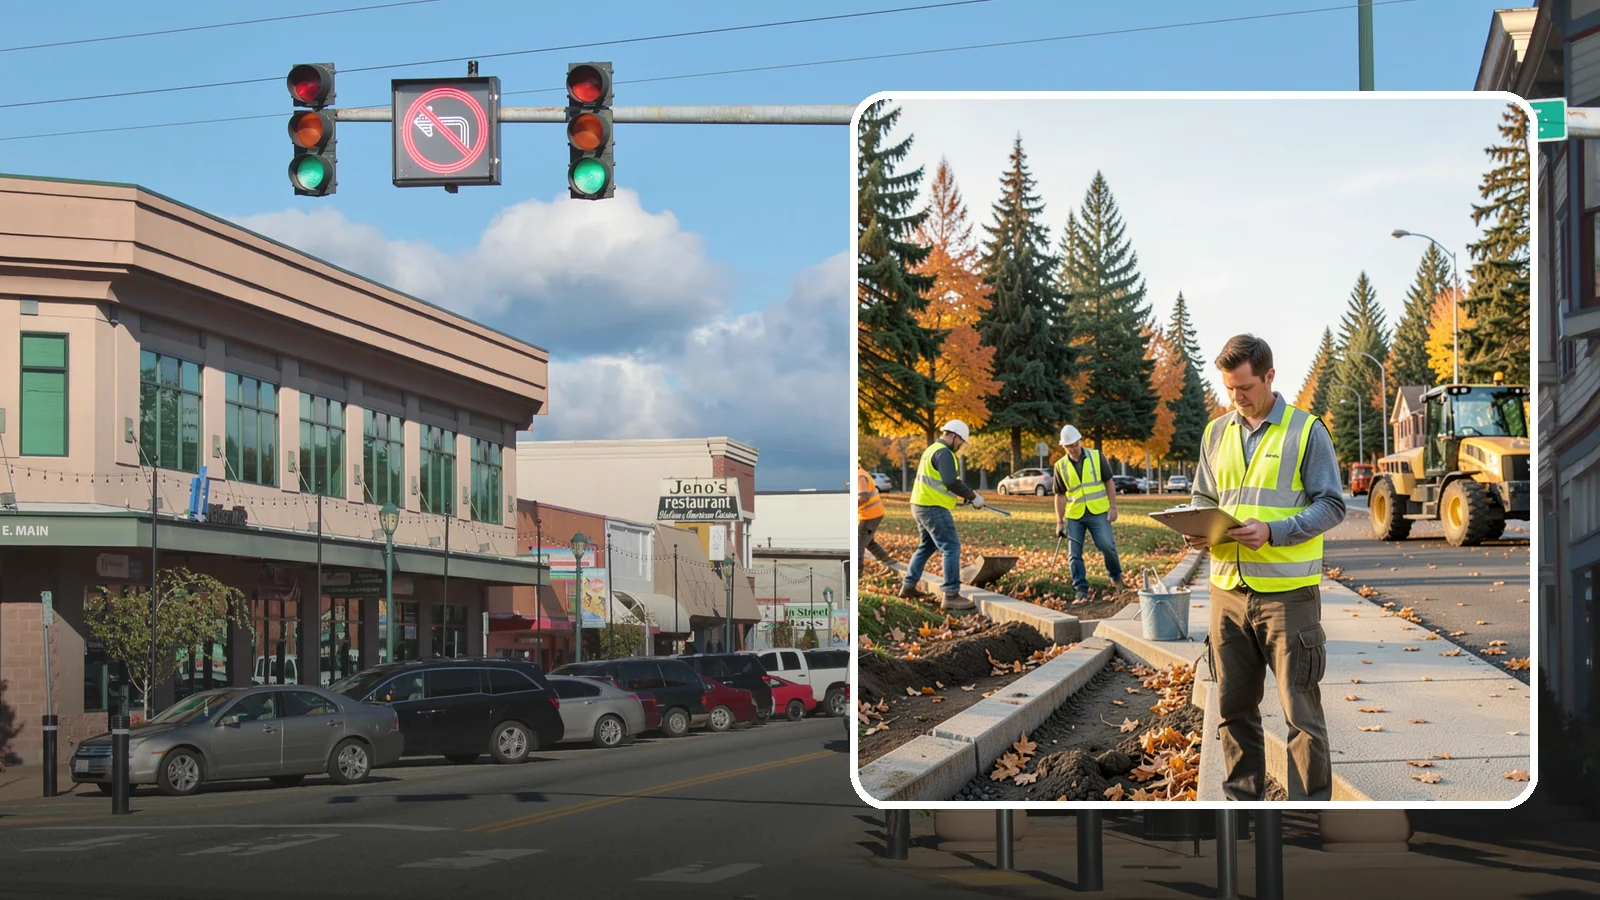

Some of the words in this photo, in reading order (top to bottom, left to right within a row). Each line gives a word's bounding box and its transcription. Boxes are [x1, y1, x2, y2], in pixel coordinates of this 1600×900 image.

[670, 480, 727, 494] Jeno's
[665, 496, 731, 509] restaurant
[659, 510, 681, 519] Italian
[686, 509, 714, 519] American
[715, 509, 737, 519] Cuisine
[2, 525, 13, 536] E.
[15, 525, 49, 536] MAIN
[797, 607, 829, 617] Street
